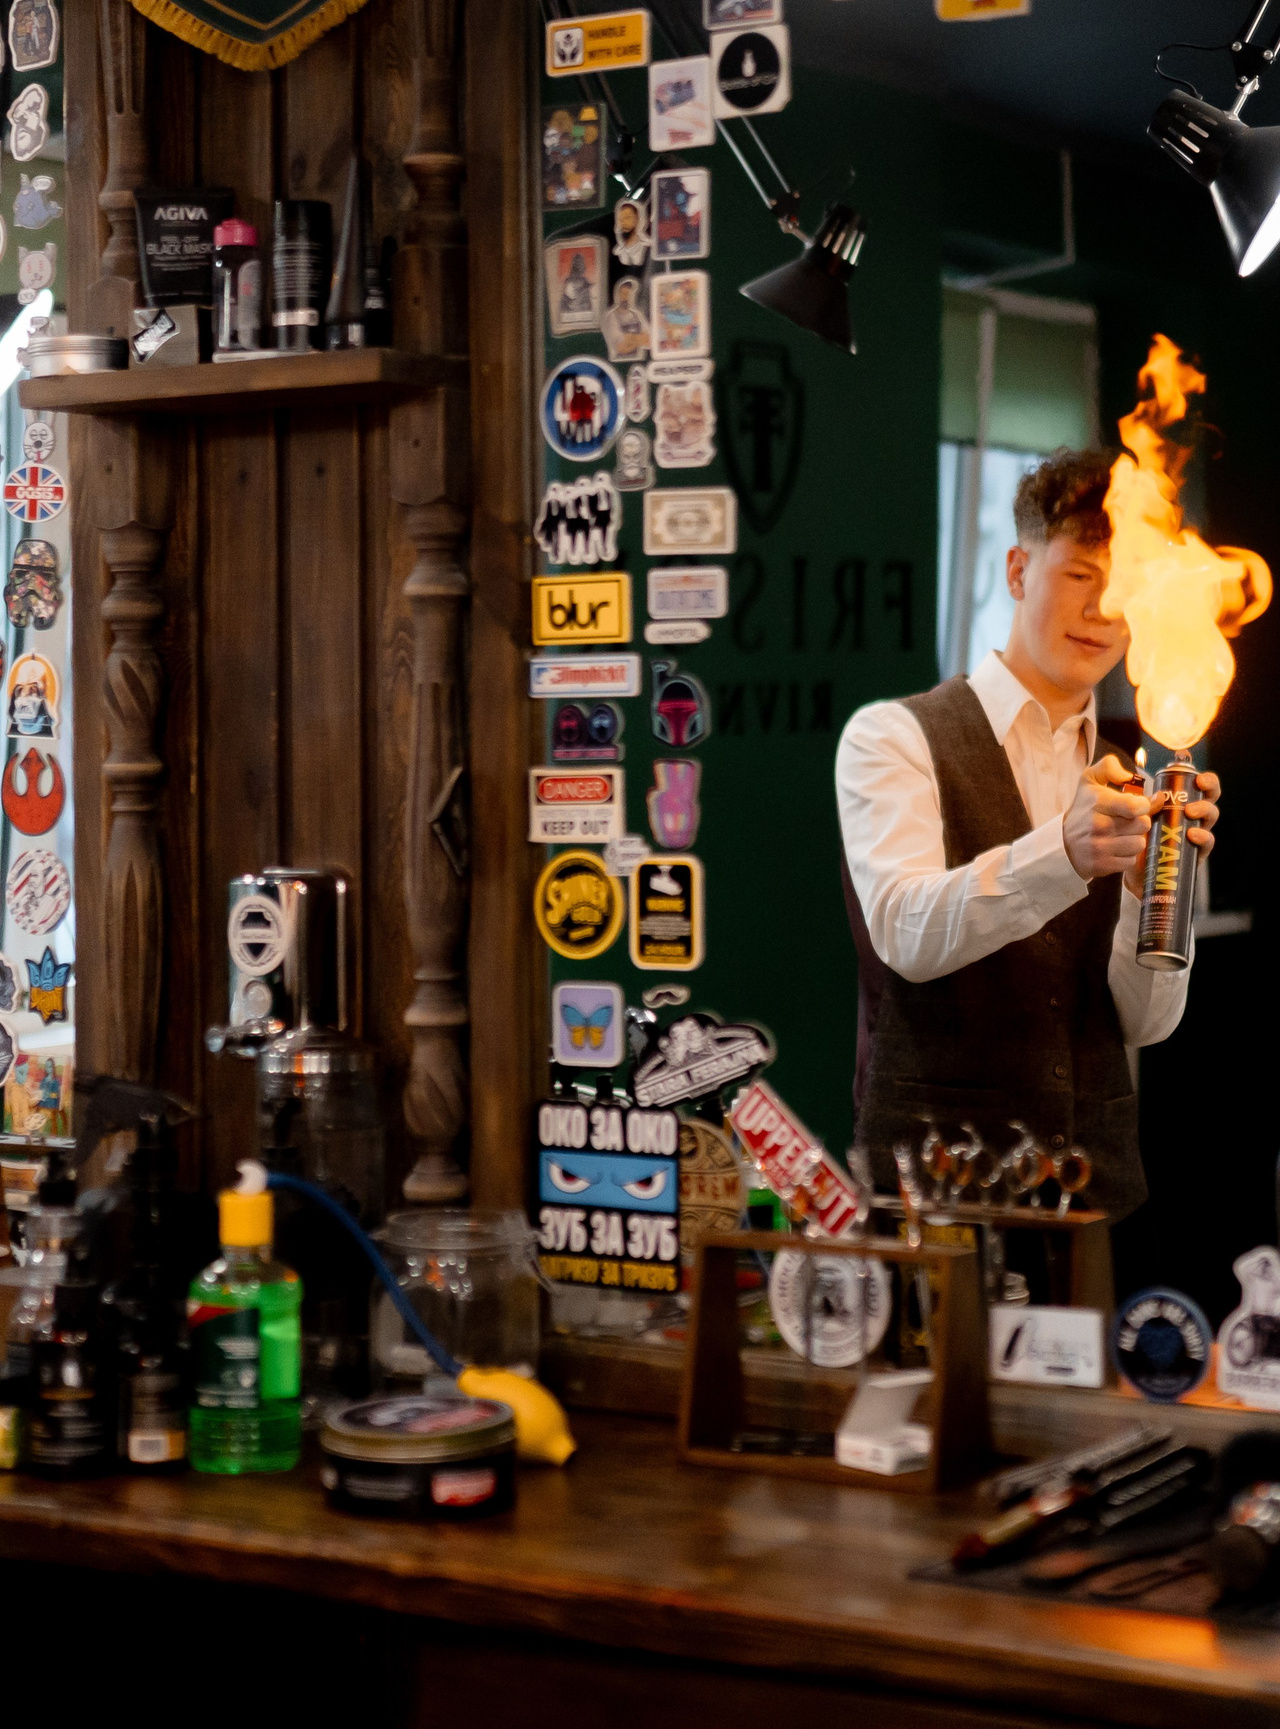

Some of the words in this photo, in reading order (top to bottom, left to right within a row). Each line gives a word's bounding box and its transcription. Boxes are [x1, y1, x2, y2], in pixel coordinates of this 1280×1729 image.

[153, 207, 209, 220] AGIVA
[146, 243, 181, 255] BLACK
[547, 589, 611, 631] blur
[542, 781, 605, 799] DANGER
[542, 820, 575, 836] KEEP
[581, 820, 609, 836] OUT
[538, 1103, 588, 1149] ОКО
[589, 1105, 625, 1152] ЗА
[626, 1109, 678, 1156] ОКО
[539, 1206, 589, 1253] ЗУБ
[589, 1210, 625, 1256] ЗА
[626, 1214, 678, 1261] ЗУБ
[600, 1260, 621, 1287] ЗА
